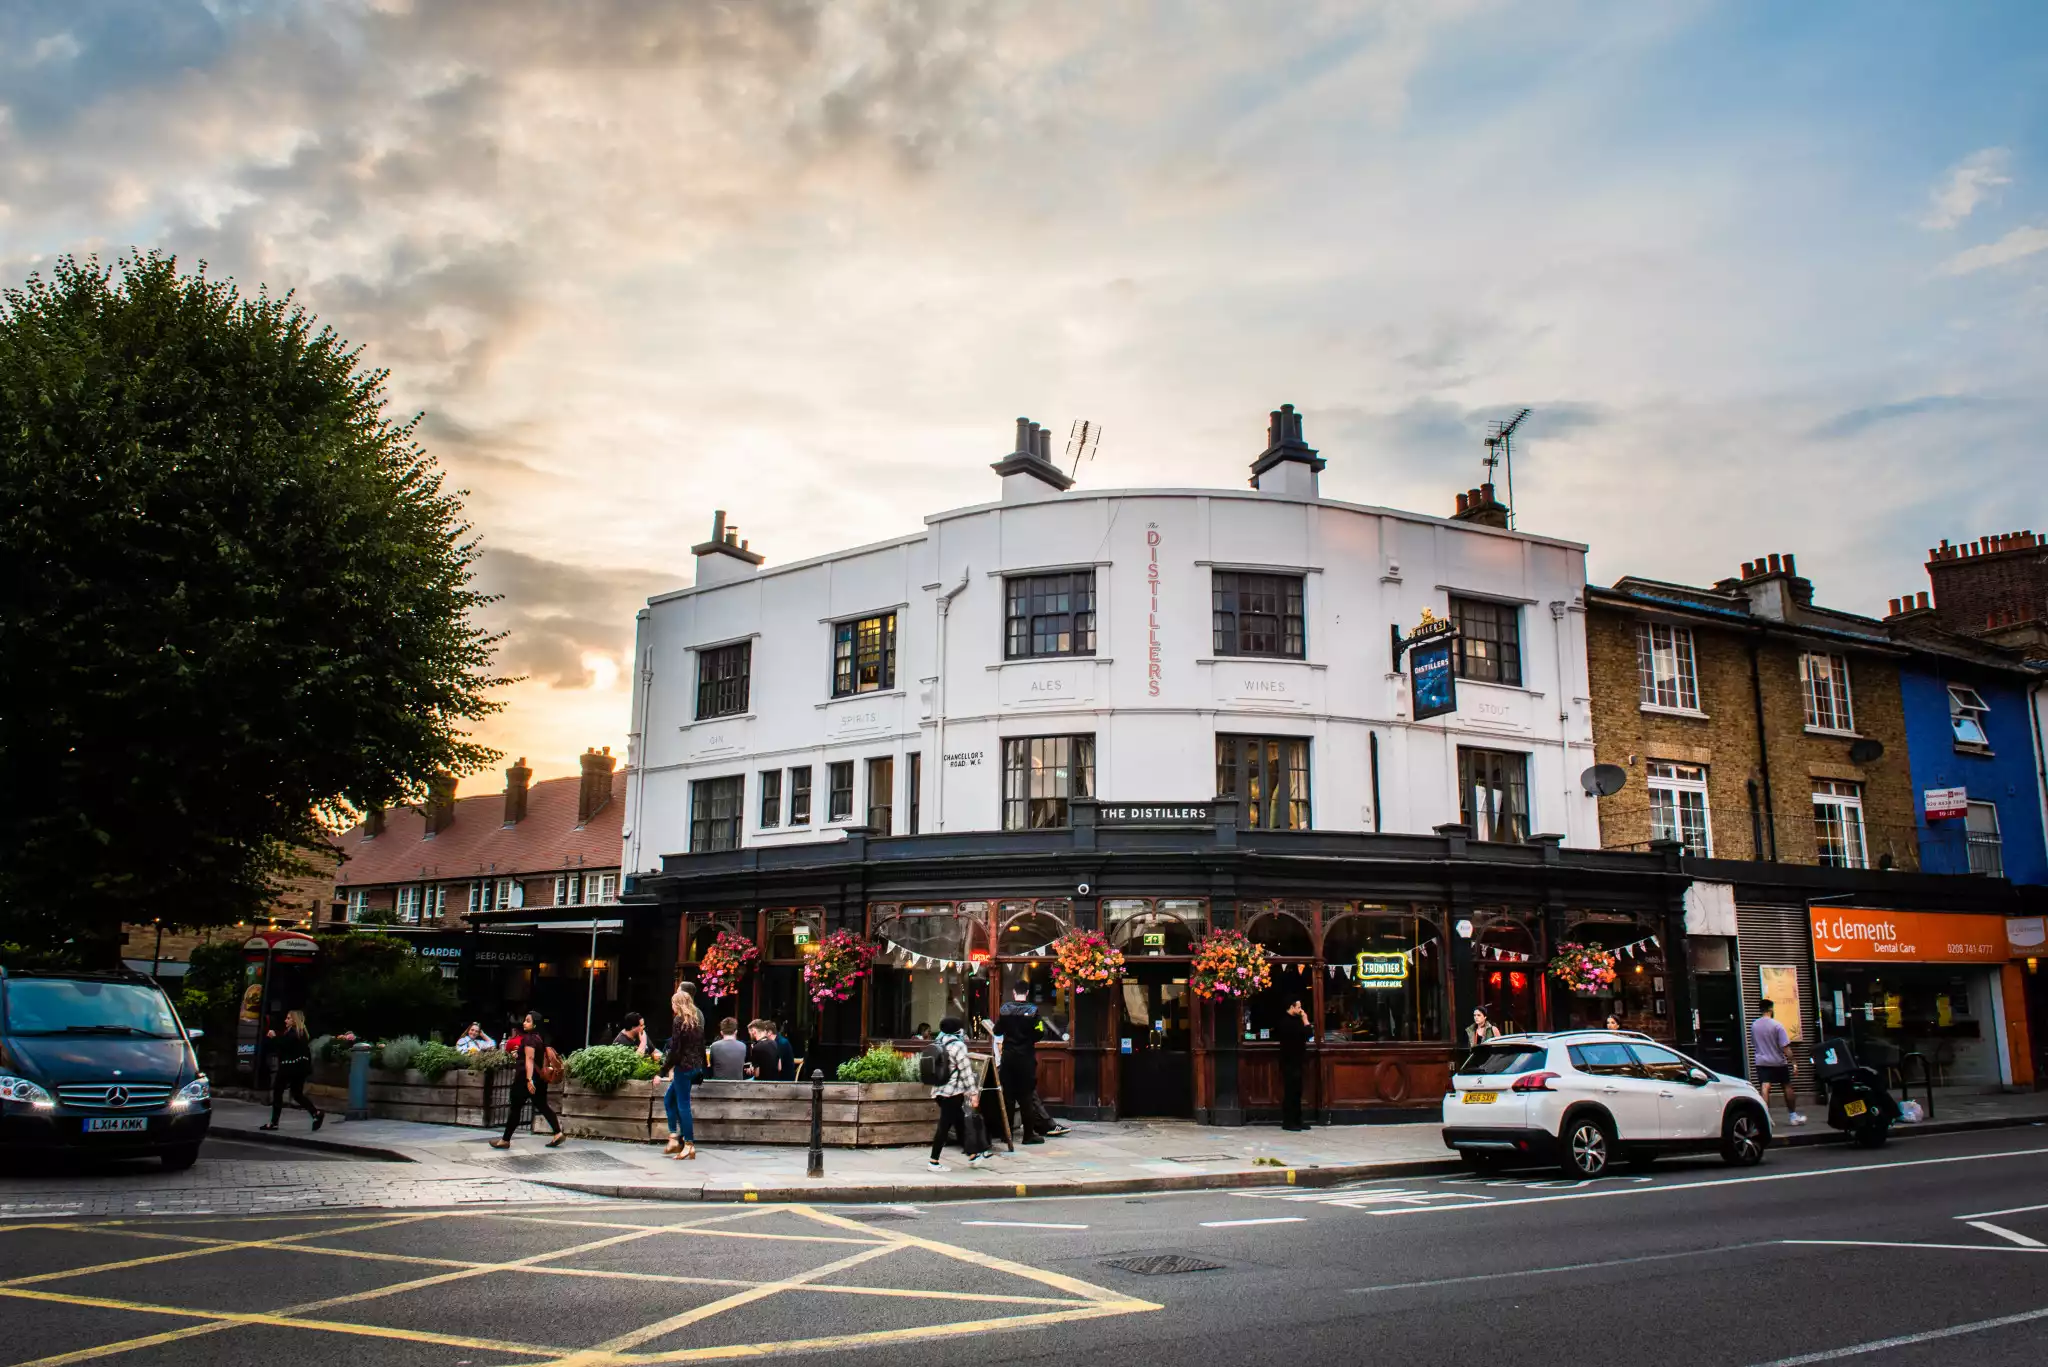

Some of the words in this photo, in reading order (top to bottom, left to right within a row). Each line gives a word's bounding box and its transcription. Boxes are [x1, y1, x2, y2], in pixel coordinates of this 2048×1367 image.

[1147, 530, 1162, 697] DISTILLERS
[1414, 658, 1449, 674] DISTILLERS
[1031, 680, 1062, 691] ALES
[1244, 680, 1286, 692] WINES
[1479, 703, 1510, 717] STOUT
[840, 712, 877, 726] SPIRITS
[708, 735, 724, 746] GIN
[1101, 808, 1126, 819] THE
[1131, 808, 1206, 819] DISTILLERS
[1815, 918, 1828, 939] st
[1832, 916, 1897, 941] clements
[422, 947, 462, 957] GARDEN
[1874, 942, 1898, 953] Dental
[1899, 943, 1916, 954] Care
[475, 952, 497, 961] BEER
[498, 952, 534, 961] GARDEN
[1364, 962, 1400, 974] FRONTIER
[93, 1119, 119, 1130] LX14
